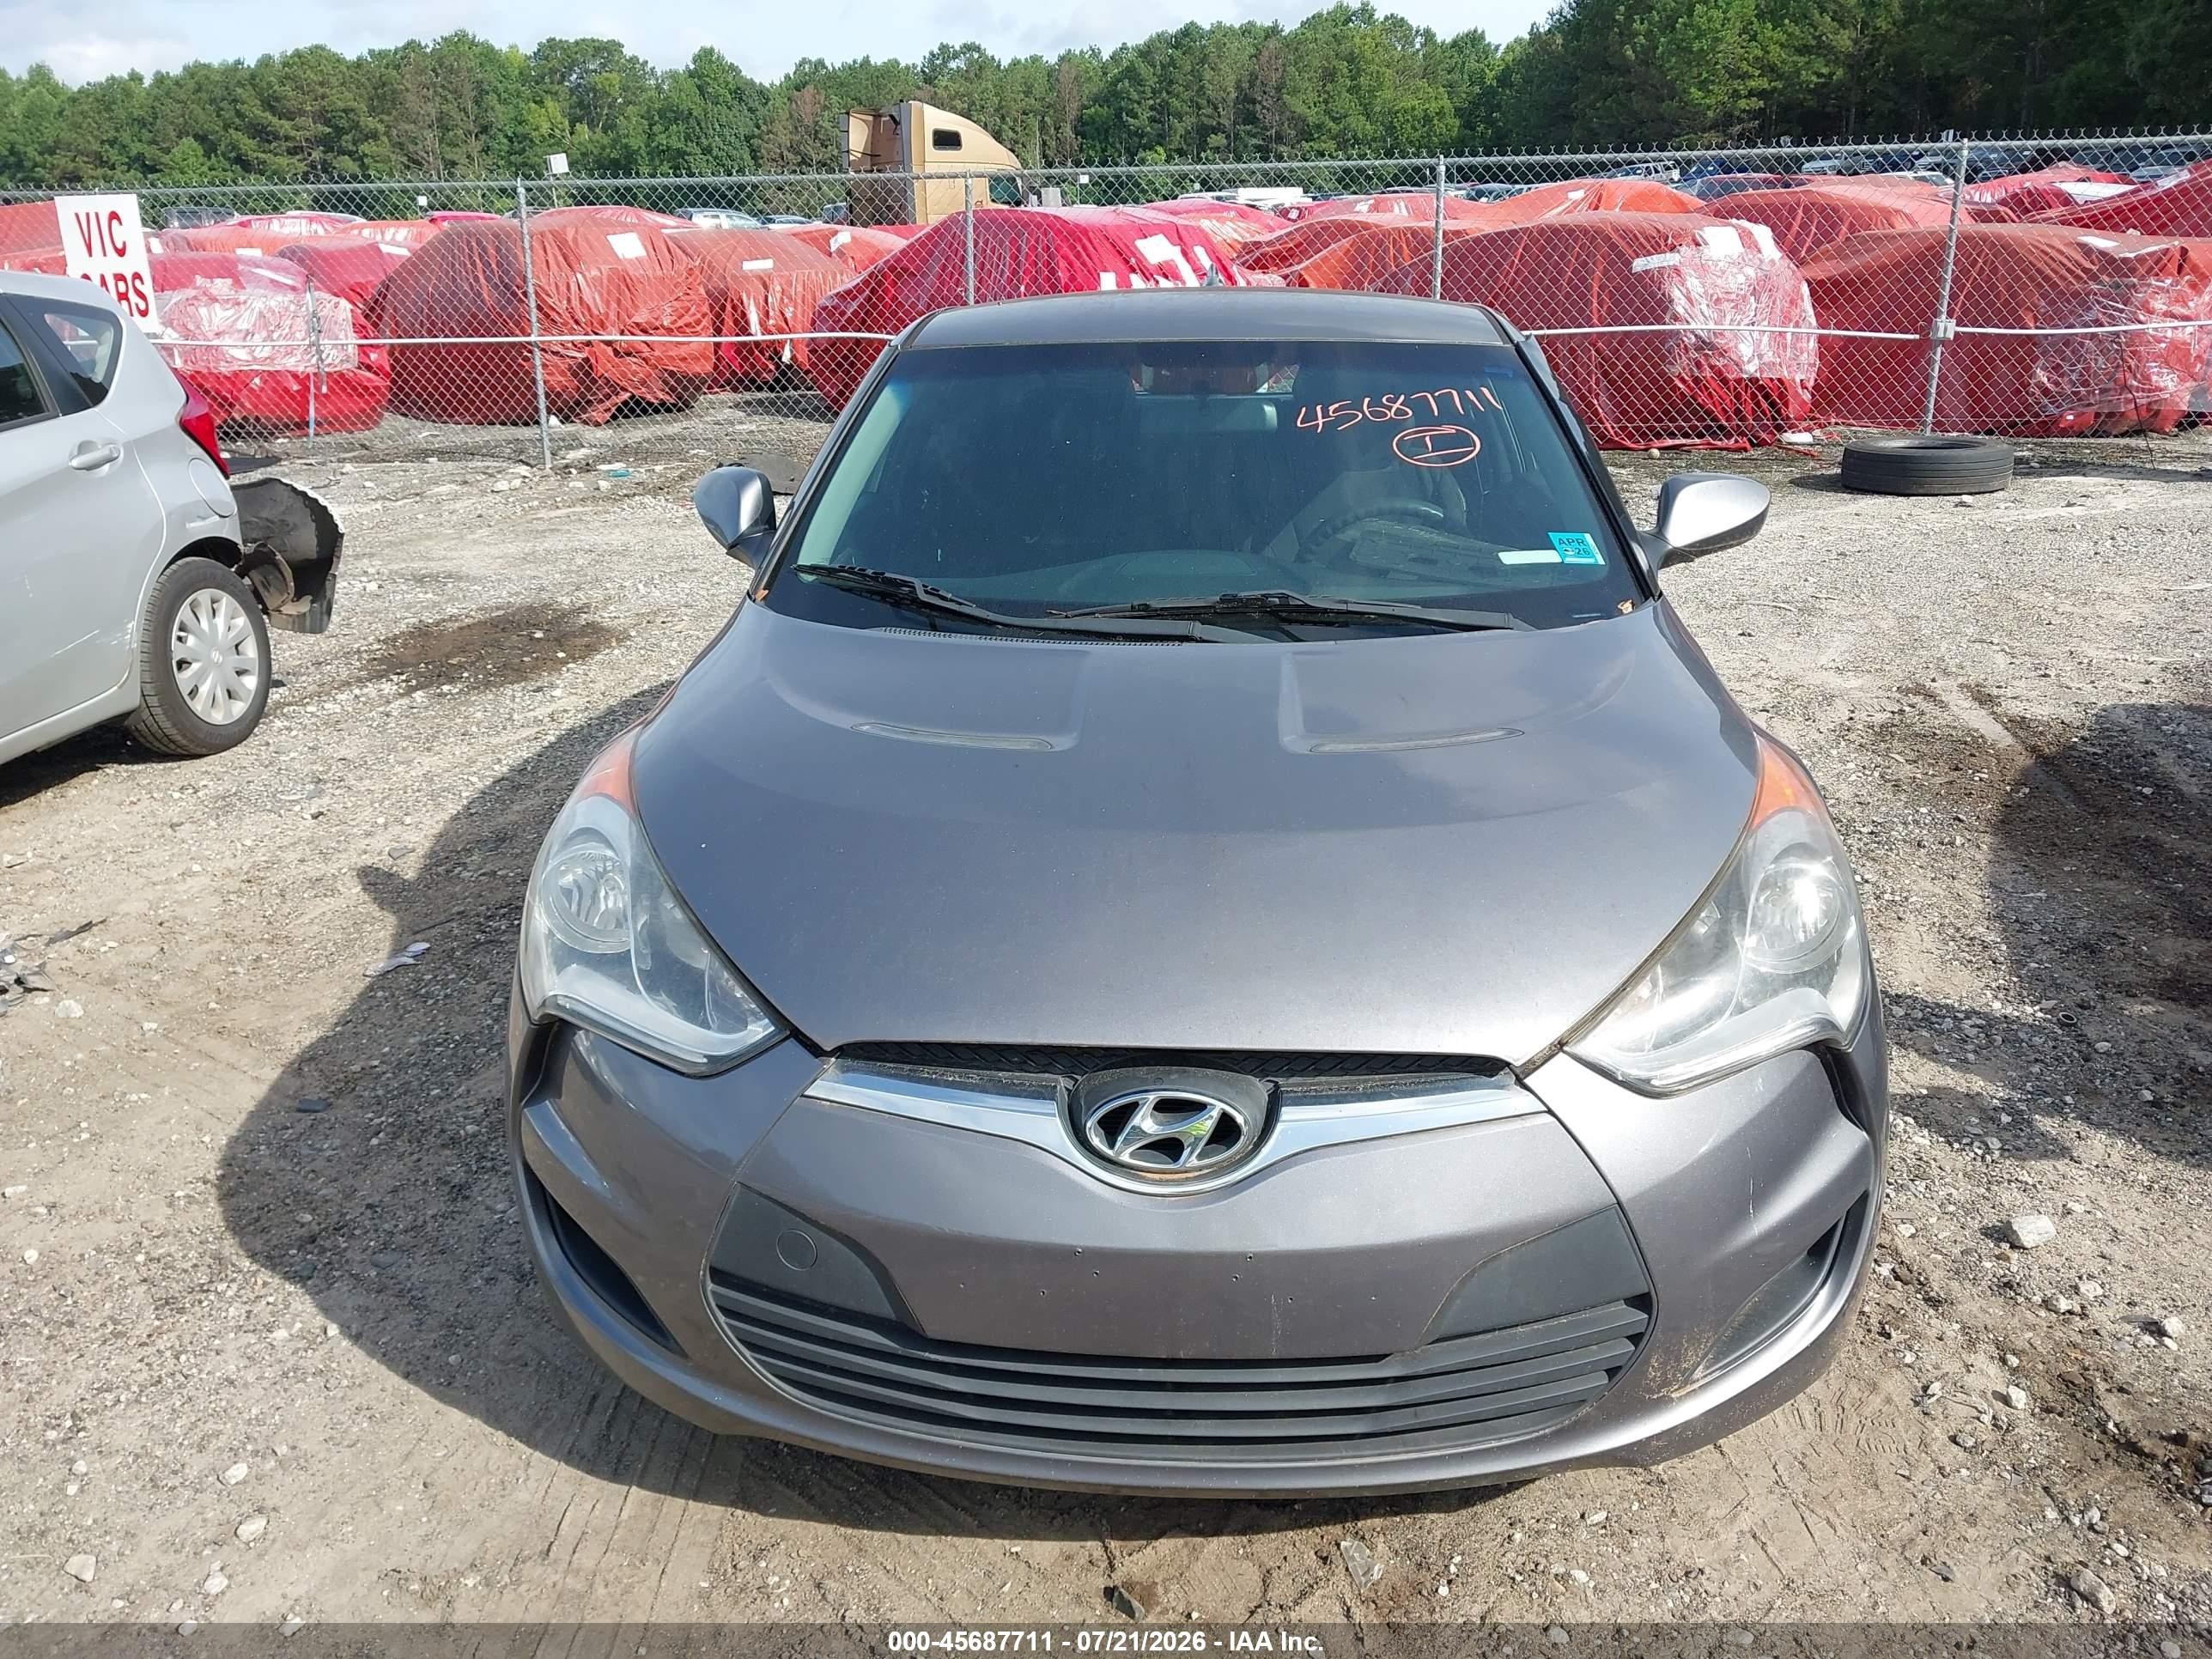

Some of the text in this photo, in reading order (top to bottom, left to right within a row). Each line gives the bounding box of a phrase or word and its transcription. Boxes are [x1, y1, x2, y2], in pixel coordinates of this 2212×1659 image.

[74, 210, 127, 258] VIC
[1296, 386, 1504, 434] 45687711
[1558, 538, 1587, 547] APR
